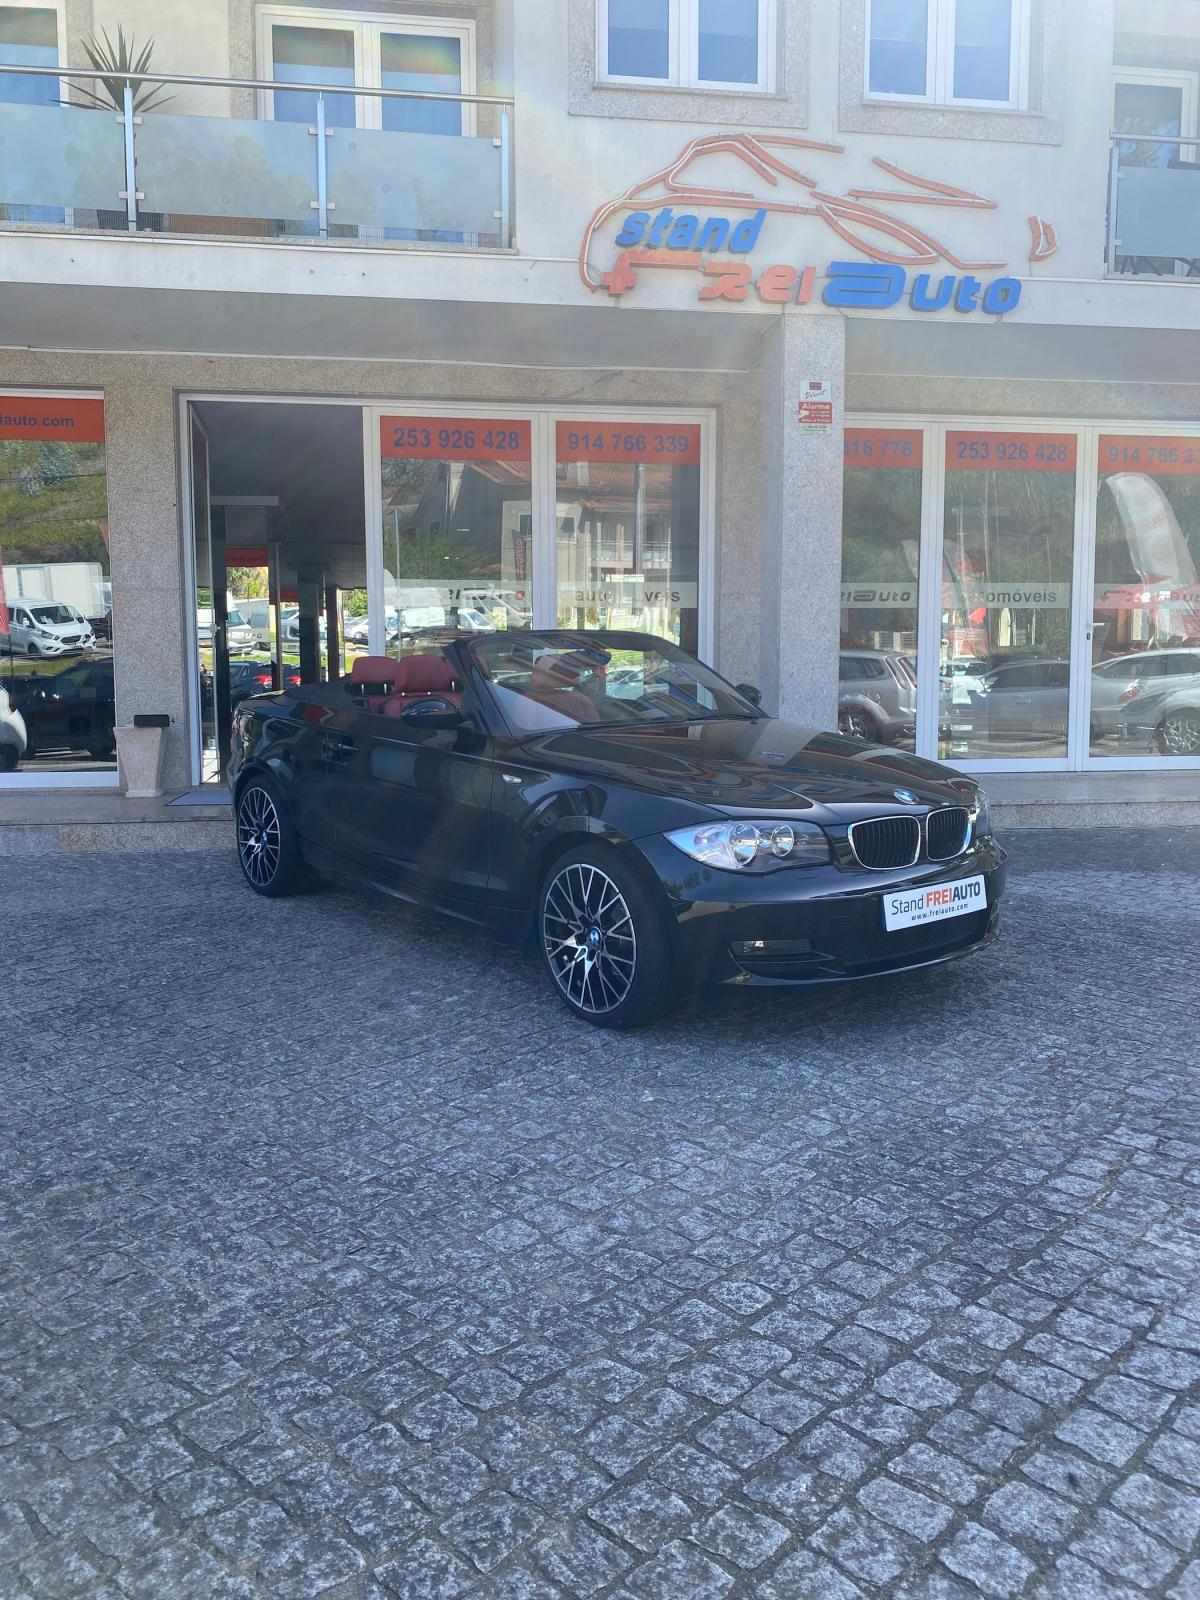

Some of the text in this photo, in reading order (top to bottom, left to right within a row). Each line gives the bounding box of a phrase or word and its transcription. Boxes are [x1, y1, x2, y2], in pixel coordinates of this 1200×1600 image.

[615, 207, 768, 254] stand
[393, 427, 520, 450] 253 926 428
[568, 432, 604, 451] 914
[611, 432, 647, 453] 766
[958, 441, 991, 460] 253
[996, 442, 1029, 461] 926
[1107, 446, 1141, 465] 914
[891, 894, 924, 916] Stand
